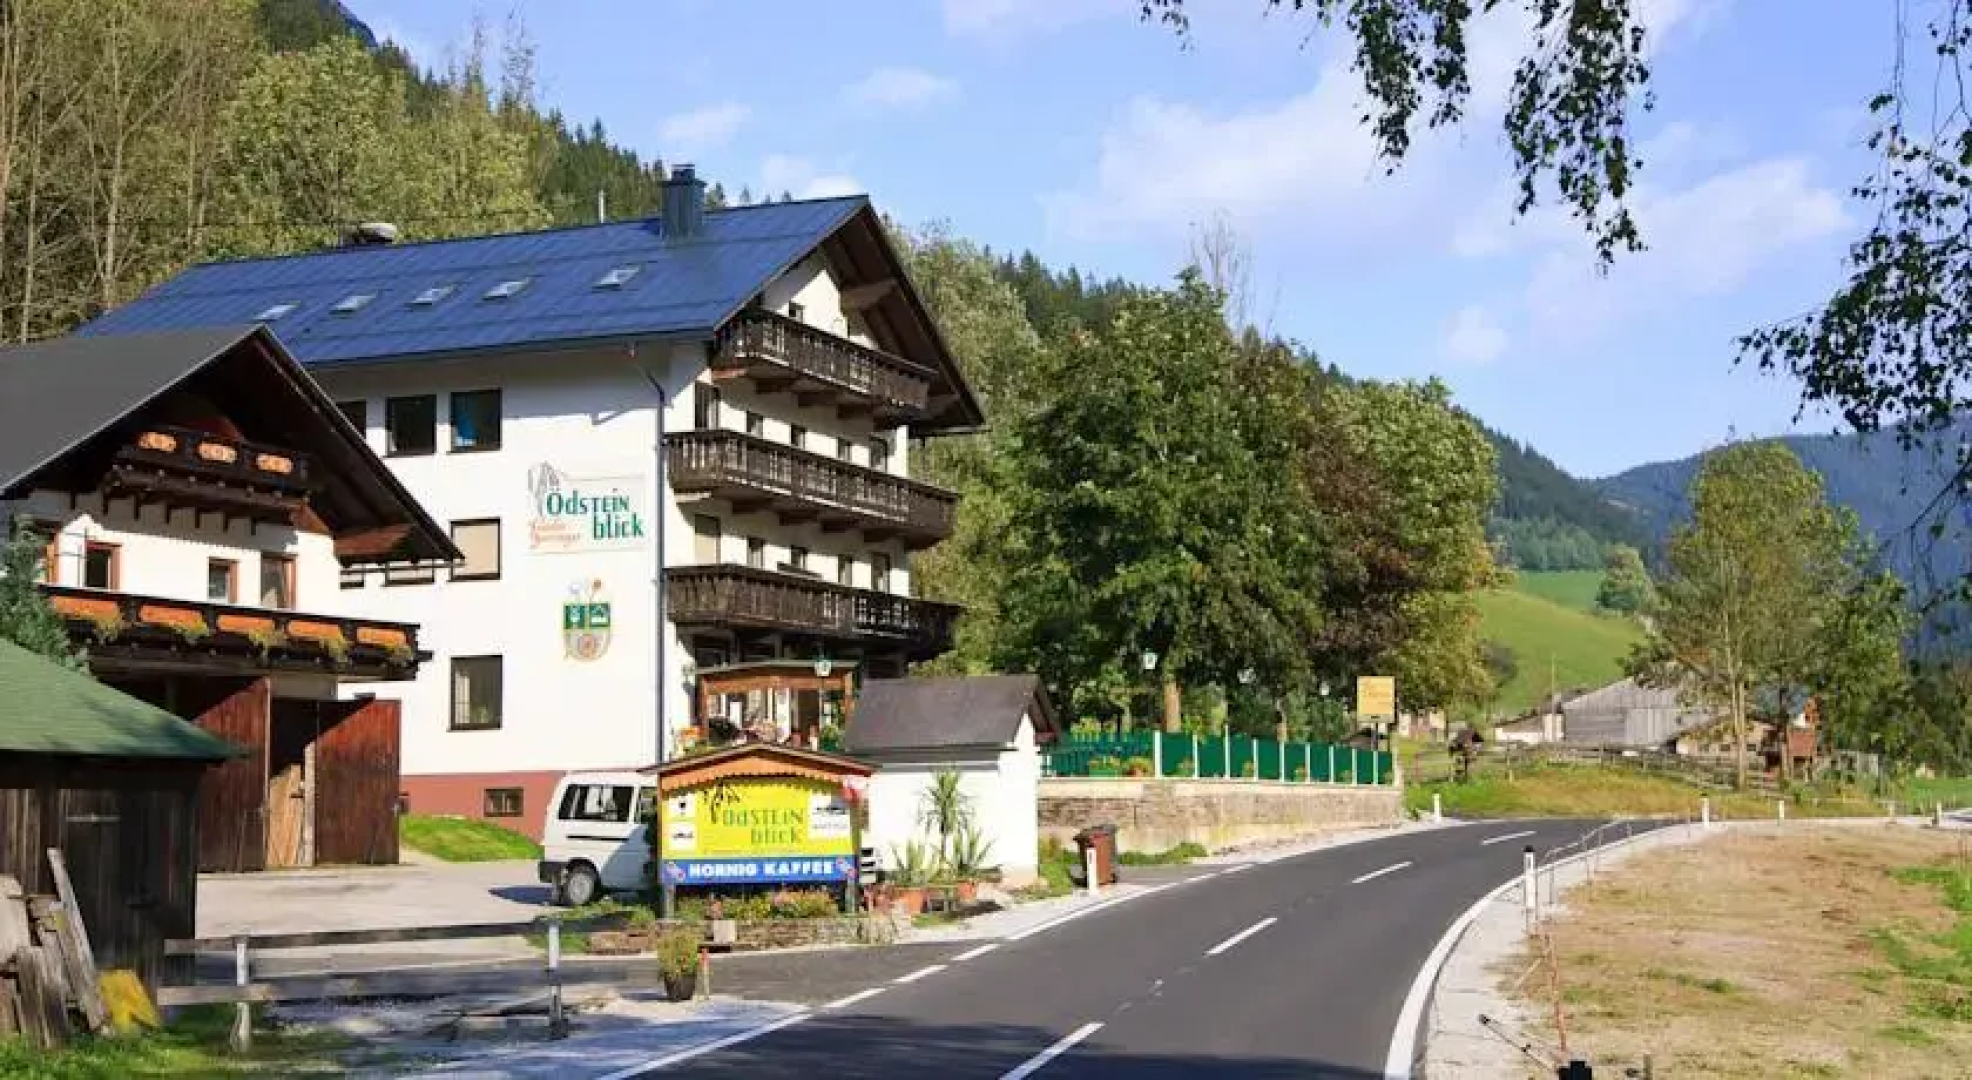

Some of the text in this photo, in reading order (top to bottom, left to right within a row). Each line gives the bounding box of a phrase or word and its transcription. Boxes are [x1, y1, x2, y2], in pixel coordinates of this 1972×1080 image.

[593, 512, 643, 540] blick
[689, 861, 833, 877] HORNIG KAFFEE
